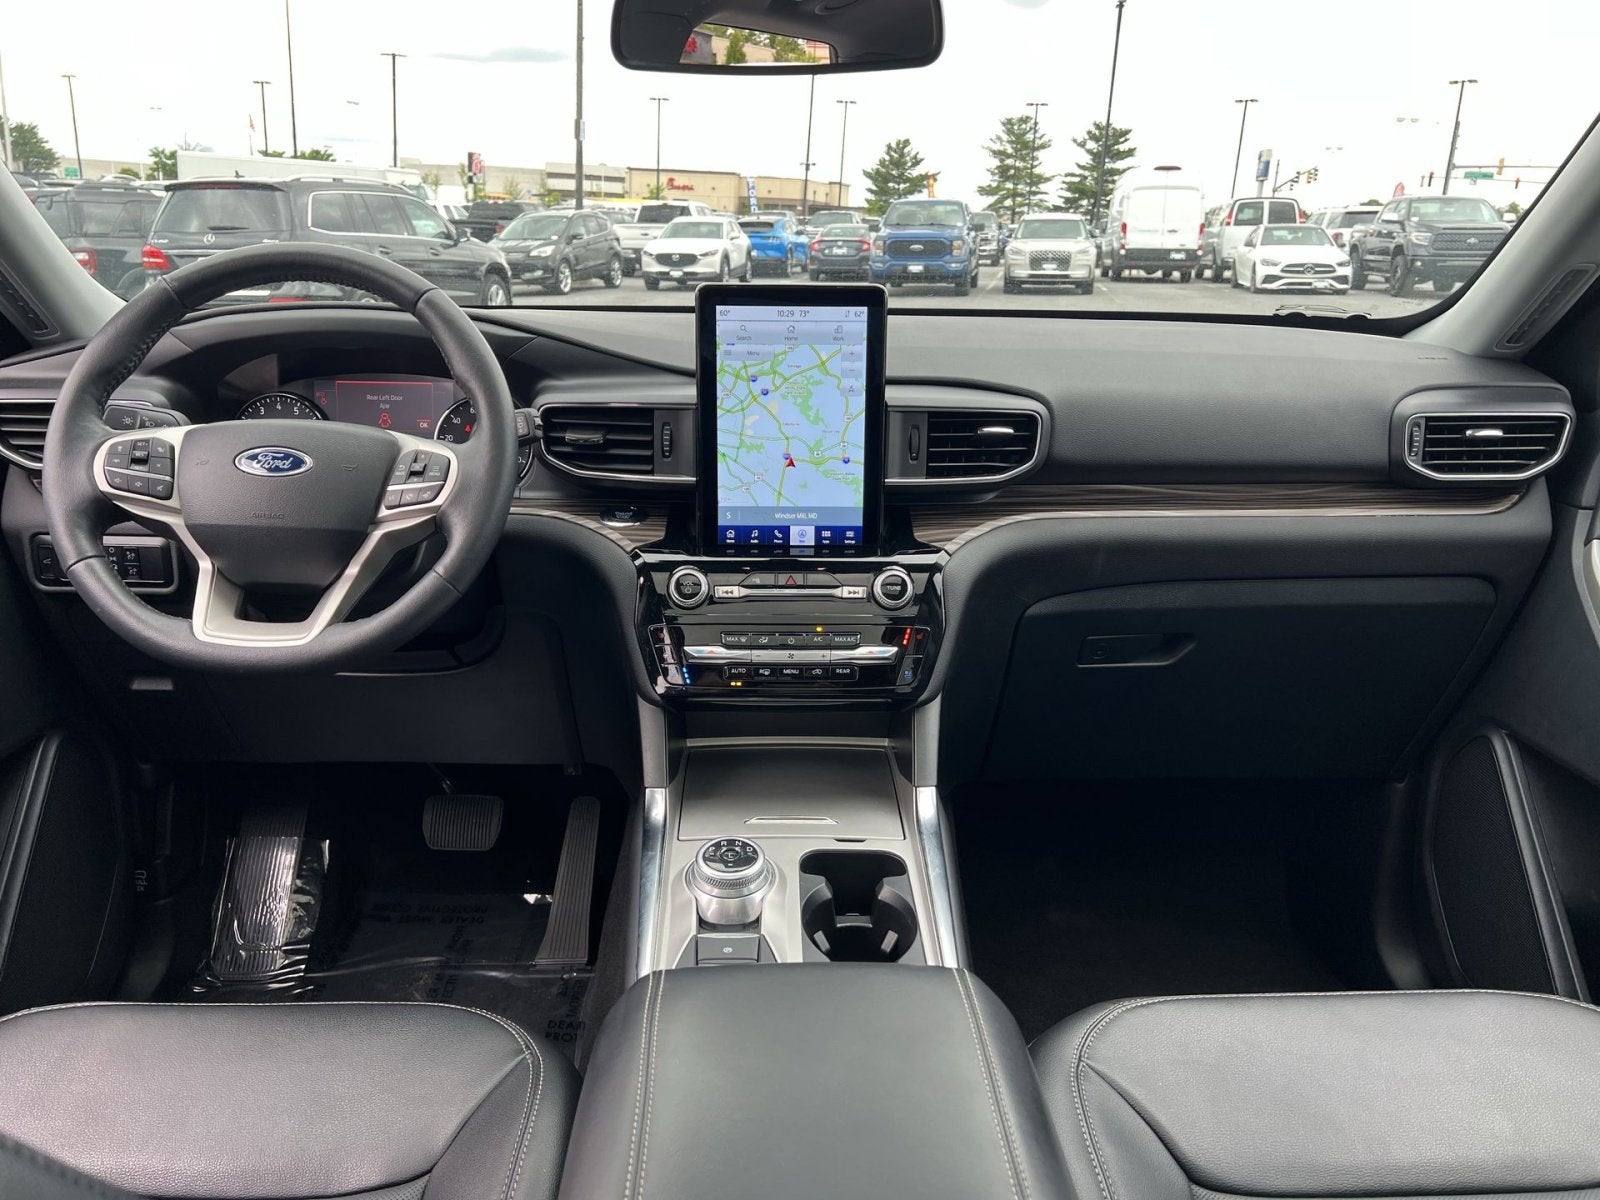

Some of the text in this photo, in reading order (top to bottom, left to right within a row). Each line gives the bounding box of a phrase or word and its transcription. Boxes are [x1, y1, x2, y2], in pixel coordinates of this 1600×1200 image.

[777, 309, 794, 318] 10:29
[276, 402, 282, 410] 4
[259, 406, 265, 415] 3
[293, 406, 300, 415] 5
[451, 417, 461, 425] 40
[444, 434, 454, 442] 20
[253, 452, 293, 469] Ford
[725, 511, 732, 519] S
